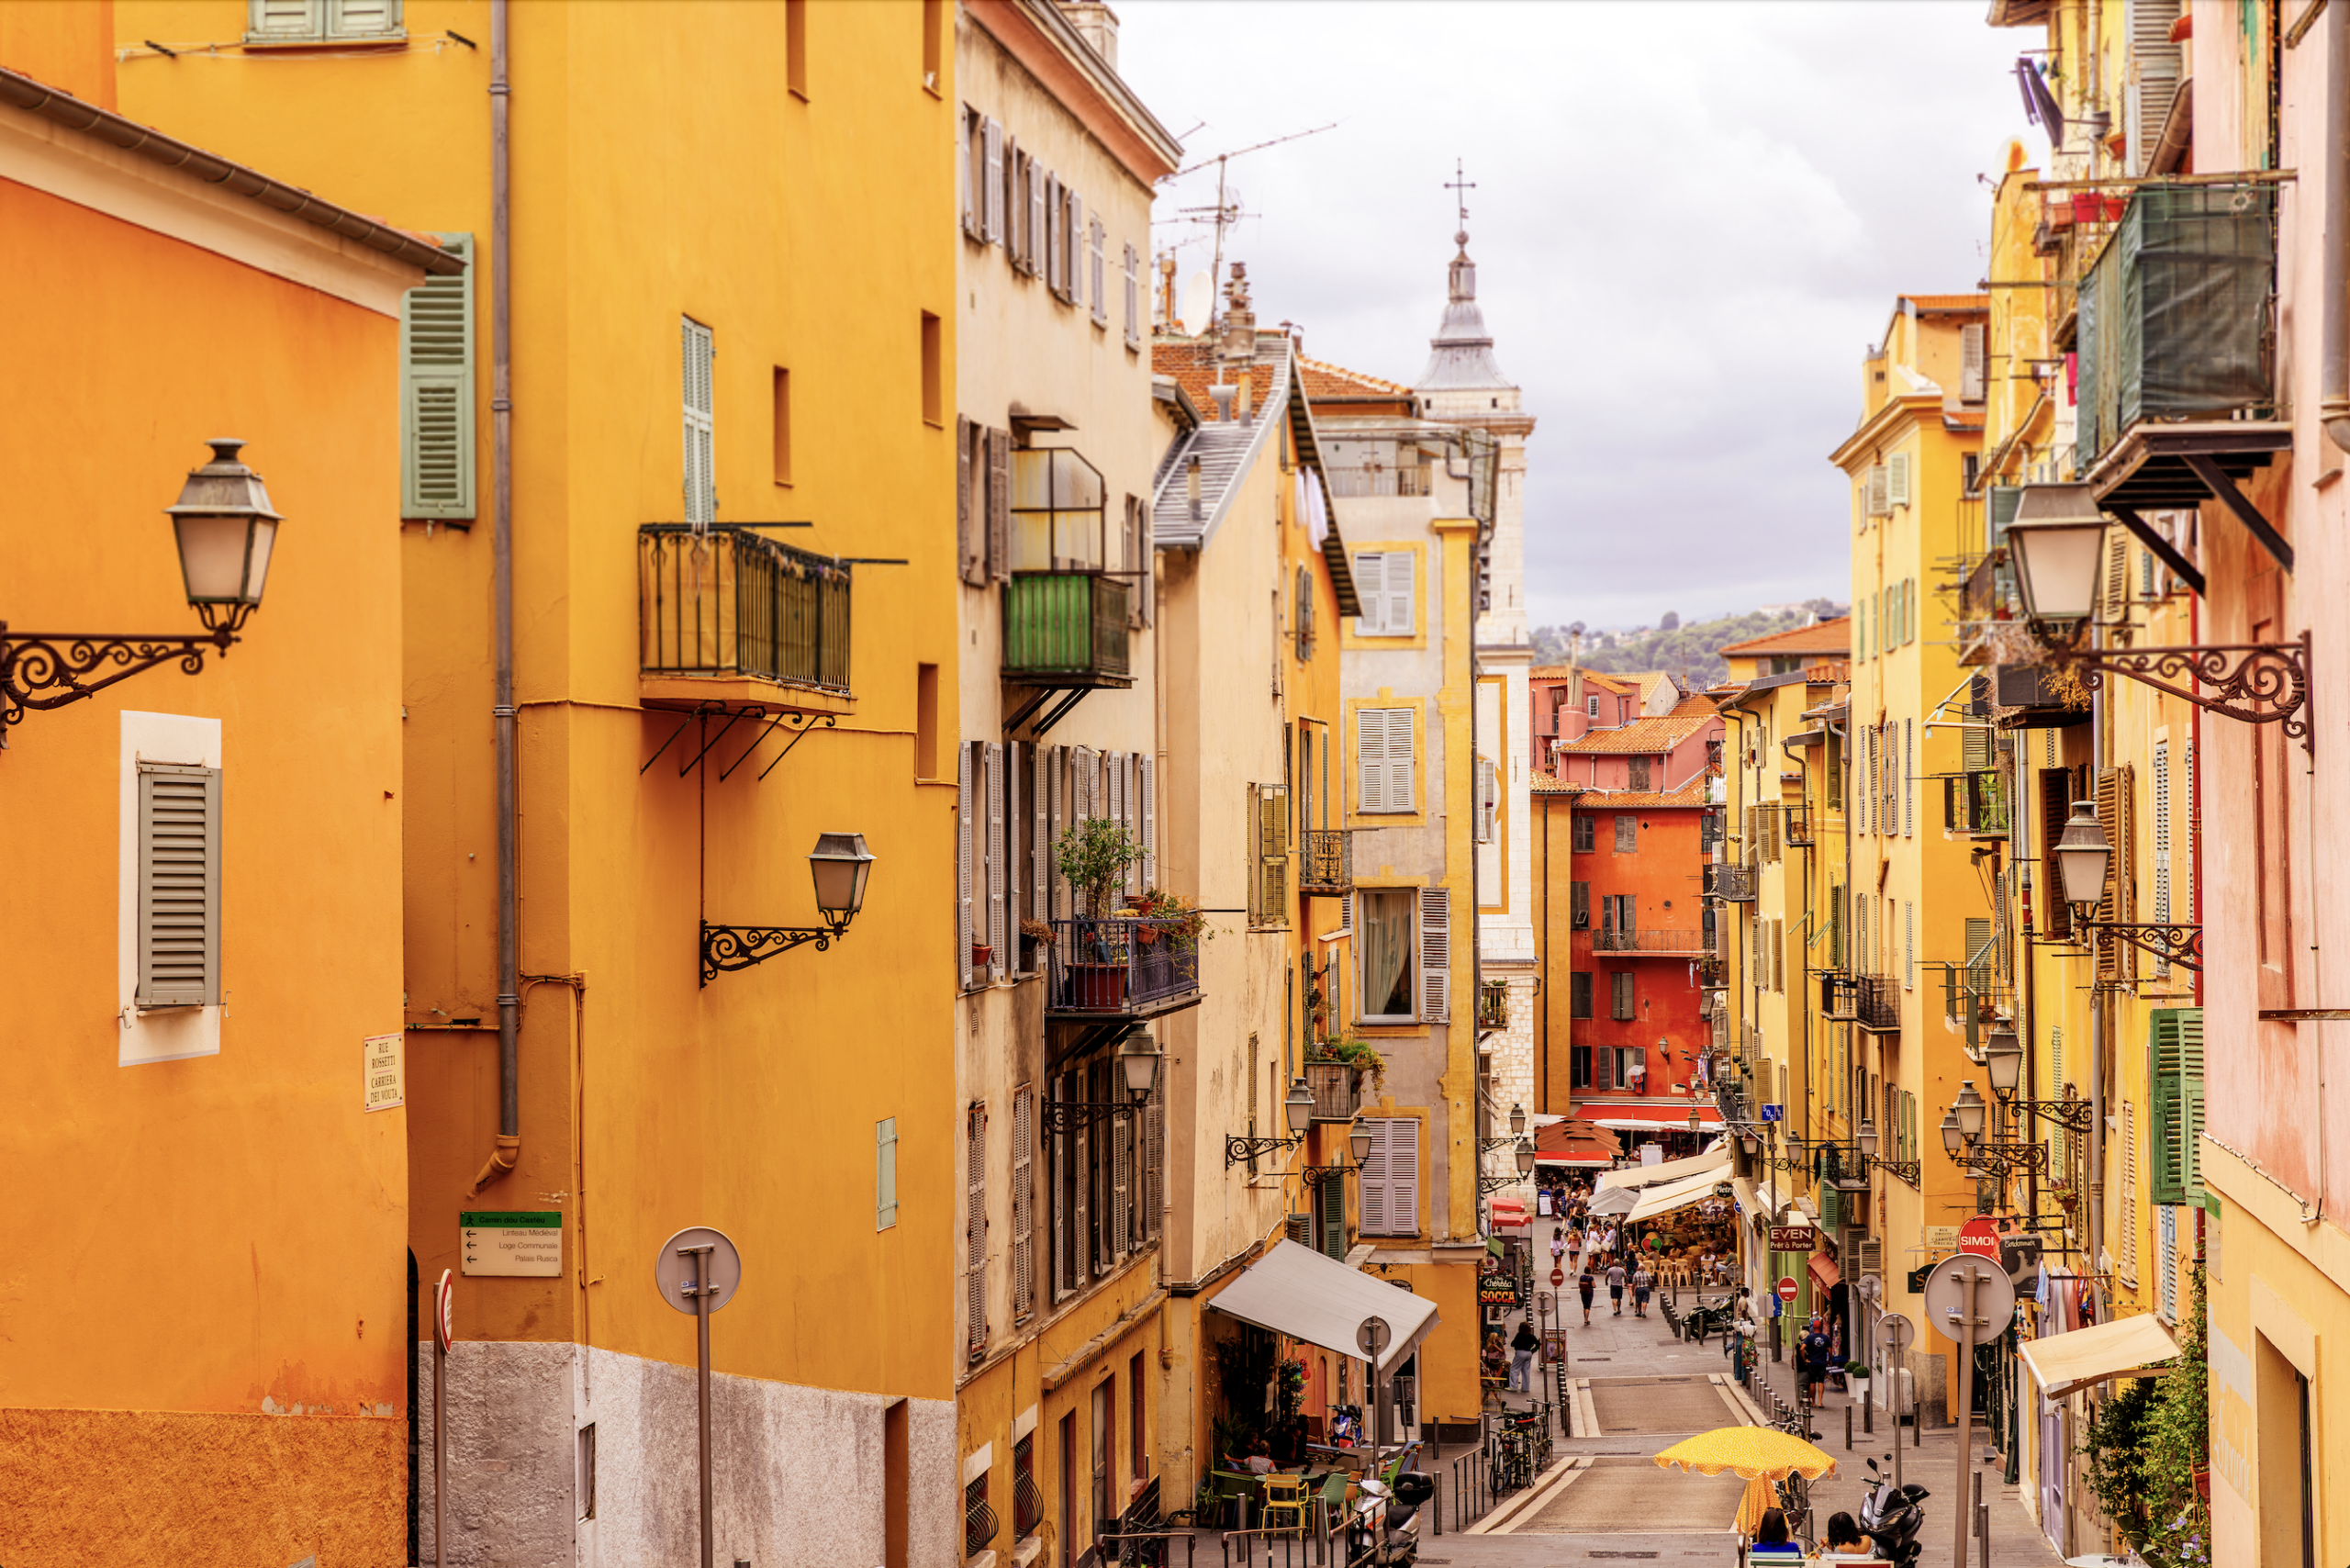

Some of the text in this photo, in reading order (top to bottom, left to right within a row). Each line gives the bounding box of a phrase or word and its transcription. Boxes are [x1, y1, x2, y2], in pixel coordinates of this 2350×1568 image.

[378, 1043, 388, 1053] RUE
[372, 1055, 395, 1069] ROSSETTI
[371, 1074, 397, 1089] CARRIERA
[371, 1092, 379, 1103] DEI
[529, 1228, 558, 1237] Médiéval
[1771, 1229, 1812, 1239] EVEN
[498, 1242, 516, 1250] Loge
[1481, 1291, 1516, 1303] SOCCA
